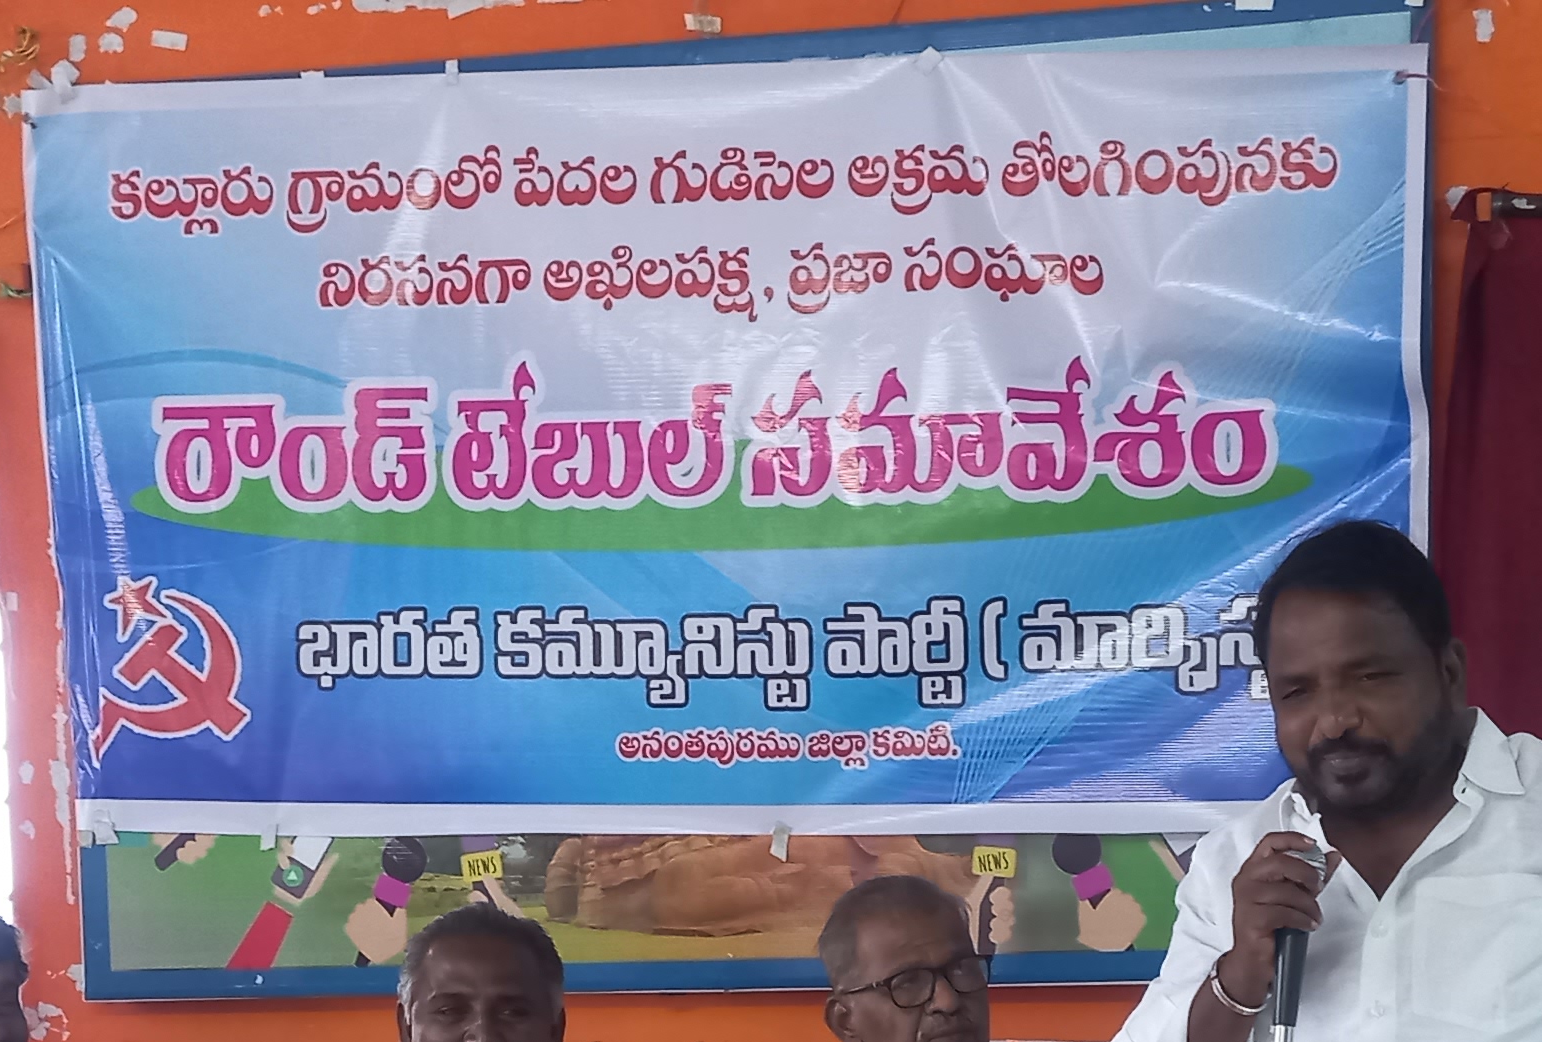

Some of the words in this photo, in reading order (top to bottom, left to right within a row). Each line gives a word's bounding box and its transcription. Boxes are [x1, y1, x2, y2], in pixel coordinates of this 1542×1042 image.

[111, 167, 272, 234] కల్లూరు
[288, 146, 500, 233] గ్రామంలో
[514, 147, 636, 206] పేదల
[651, 147, 835, 205] గుడిసెల
[848, 144, 986, 214] అక్రమ
[320, 255, 532, 309] నిరసనగా
[789, 242, 891, 314] ప్రజా
[904, 238, 1104, 302] సంఘాల
[161, 386, 429, 504] రౌండ్
[452, 360, 732, 500] టేబుల్
[751, 356, 1264, 498] సమావేశం
[299, 611, 479, 688] భారత
[497, 605, 809, 707] కమ్యూనిస్టు
[828, 598, 964, 706] పార్టీ
[617, 728, 802, 764] అనంతపురము
[467, 856, 498, 877] NEWS
[977, 852, 1009, 872] NEWS
